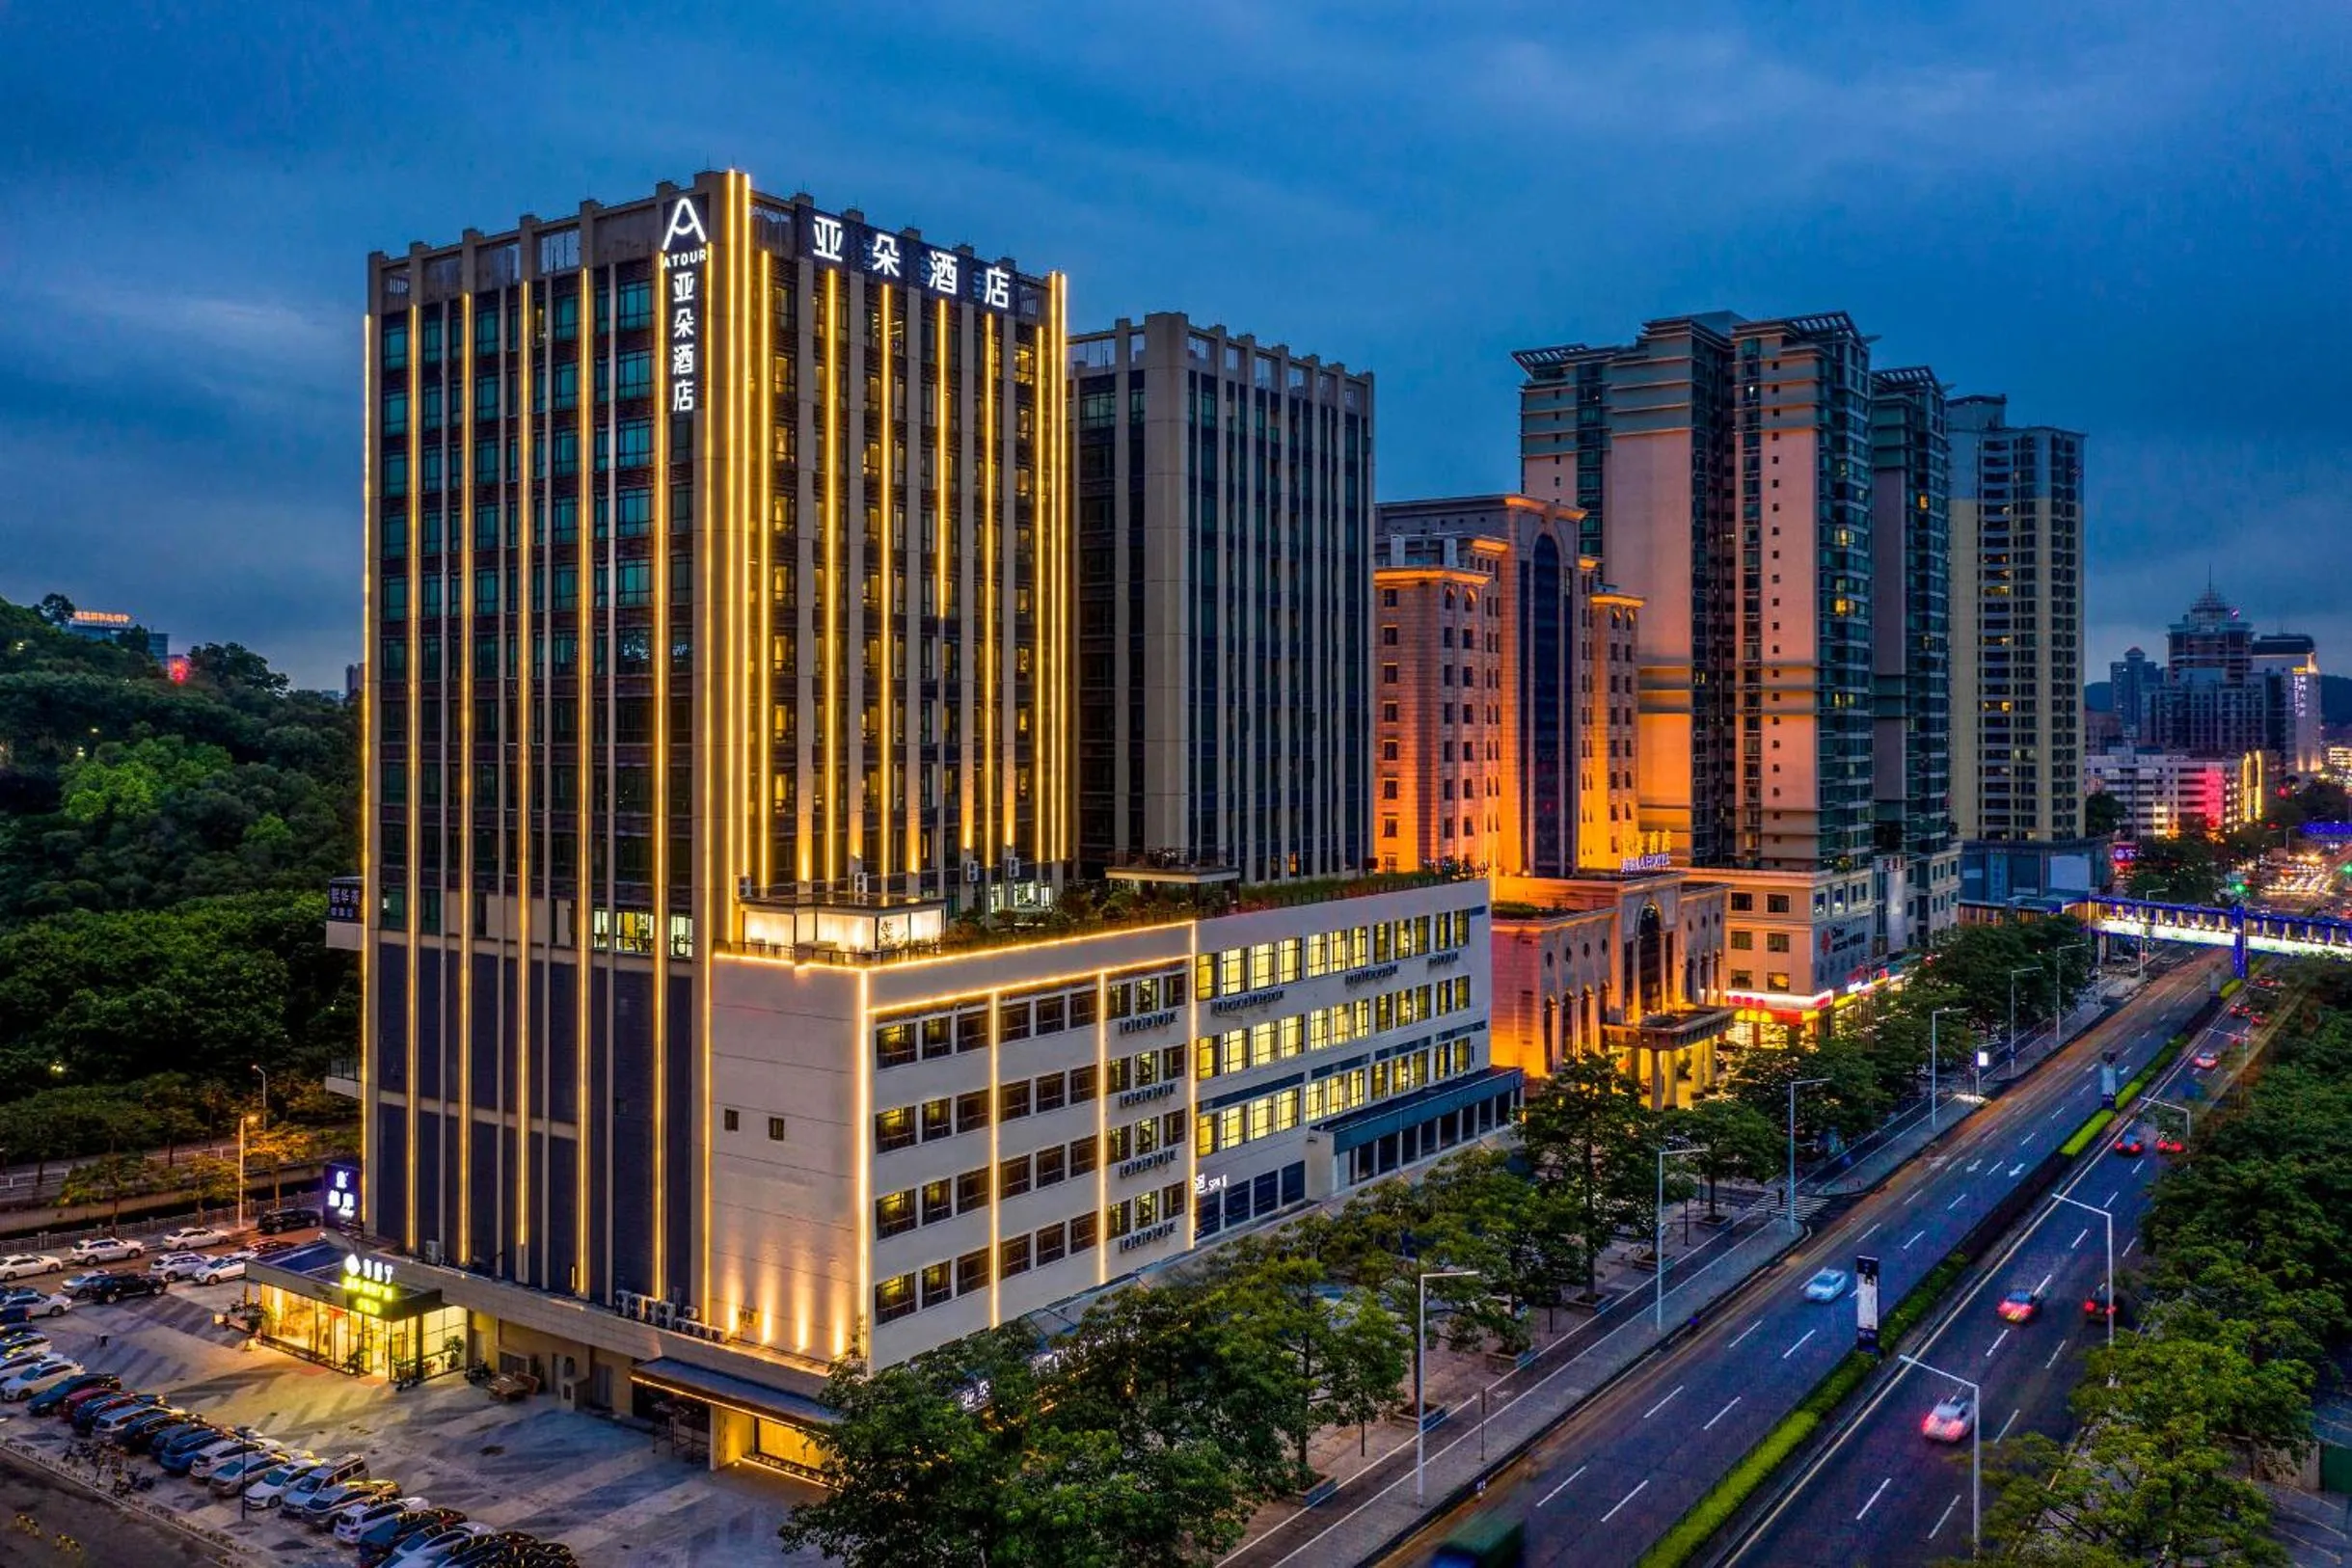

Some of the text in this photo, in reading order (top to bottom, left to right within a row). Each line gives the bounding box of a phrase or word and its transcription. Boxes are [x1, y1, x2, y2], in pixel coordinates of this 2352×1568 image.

[662, 248, 707, 270] ATOUR
[812, 215, 1011, 310] 亚朵酒店
[672, 271, 695, 412] 亚朵酒店
